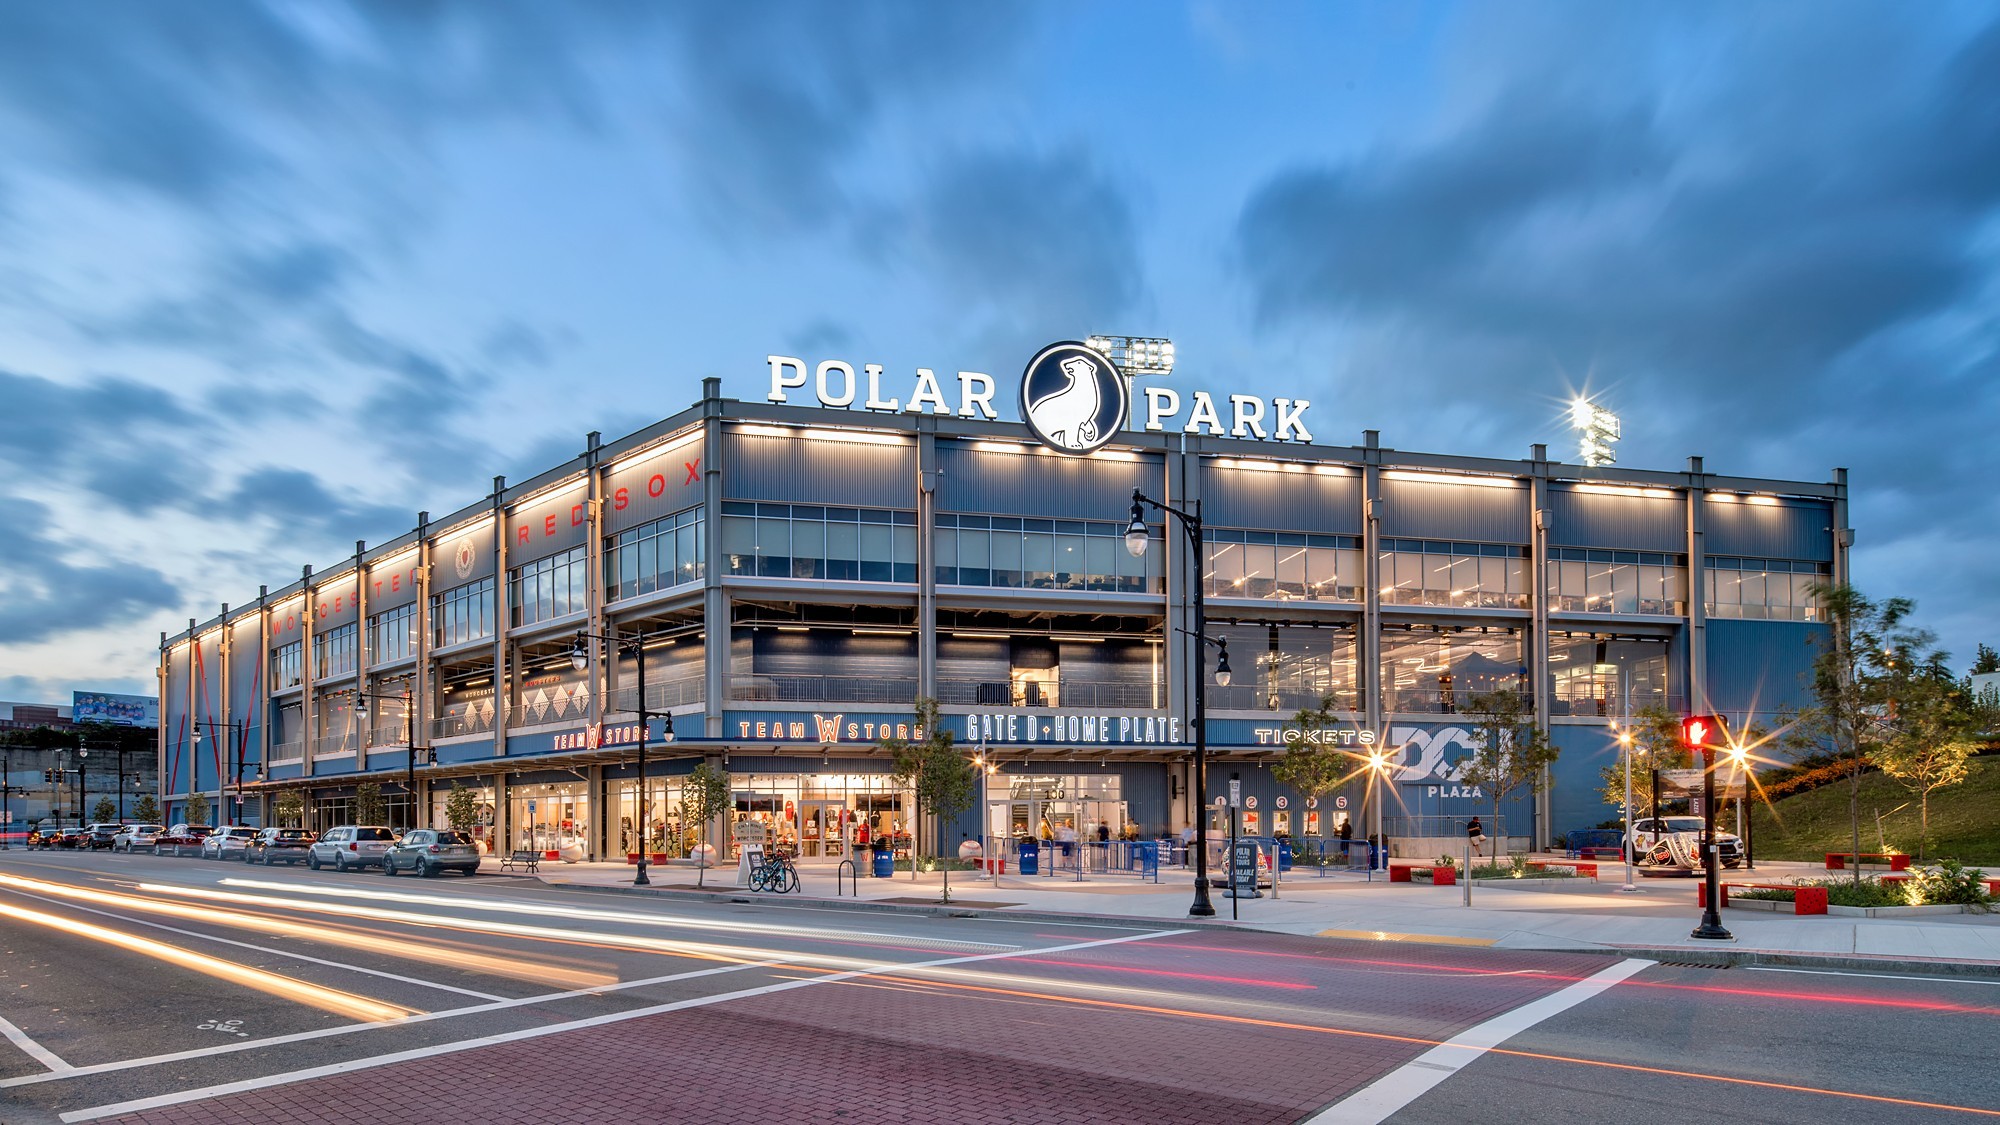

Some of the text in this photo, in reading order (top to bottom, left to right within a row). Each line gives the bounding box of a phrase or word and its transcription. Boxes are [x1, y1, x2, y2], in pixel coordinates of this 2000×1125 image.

[768, 355, 1313, 441] POLAR PARK
[273, 458, 700, 635] WOCESTE RED SOX
[465, 688, 495, 698] WORCESTE
[740, 714, 923, 743] TEAM W STORE
[967, 714, 1179, 742] GATE D HOME PLATE
[554, 732, 585, 750] TEAM
[586, 722, 601, 750] W
[1255, 729, 1375, 745] TICKETS
[1044, 790, 1065, 800] 100
[1428, 785, 1482, 798] PLAZA
[1247, 798, 1256, 807] 2
[1278, 798, 1286, 807] 3
[1337, 798, 1346, 807] 5
[1236, 848, 1250, 856] POLAR
